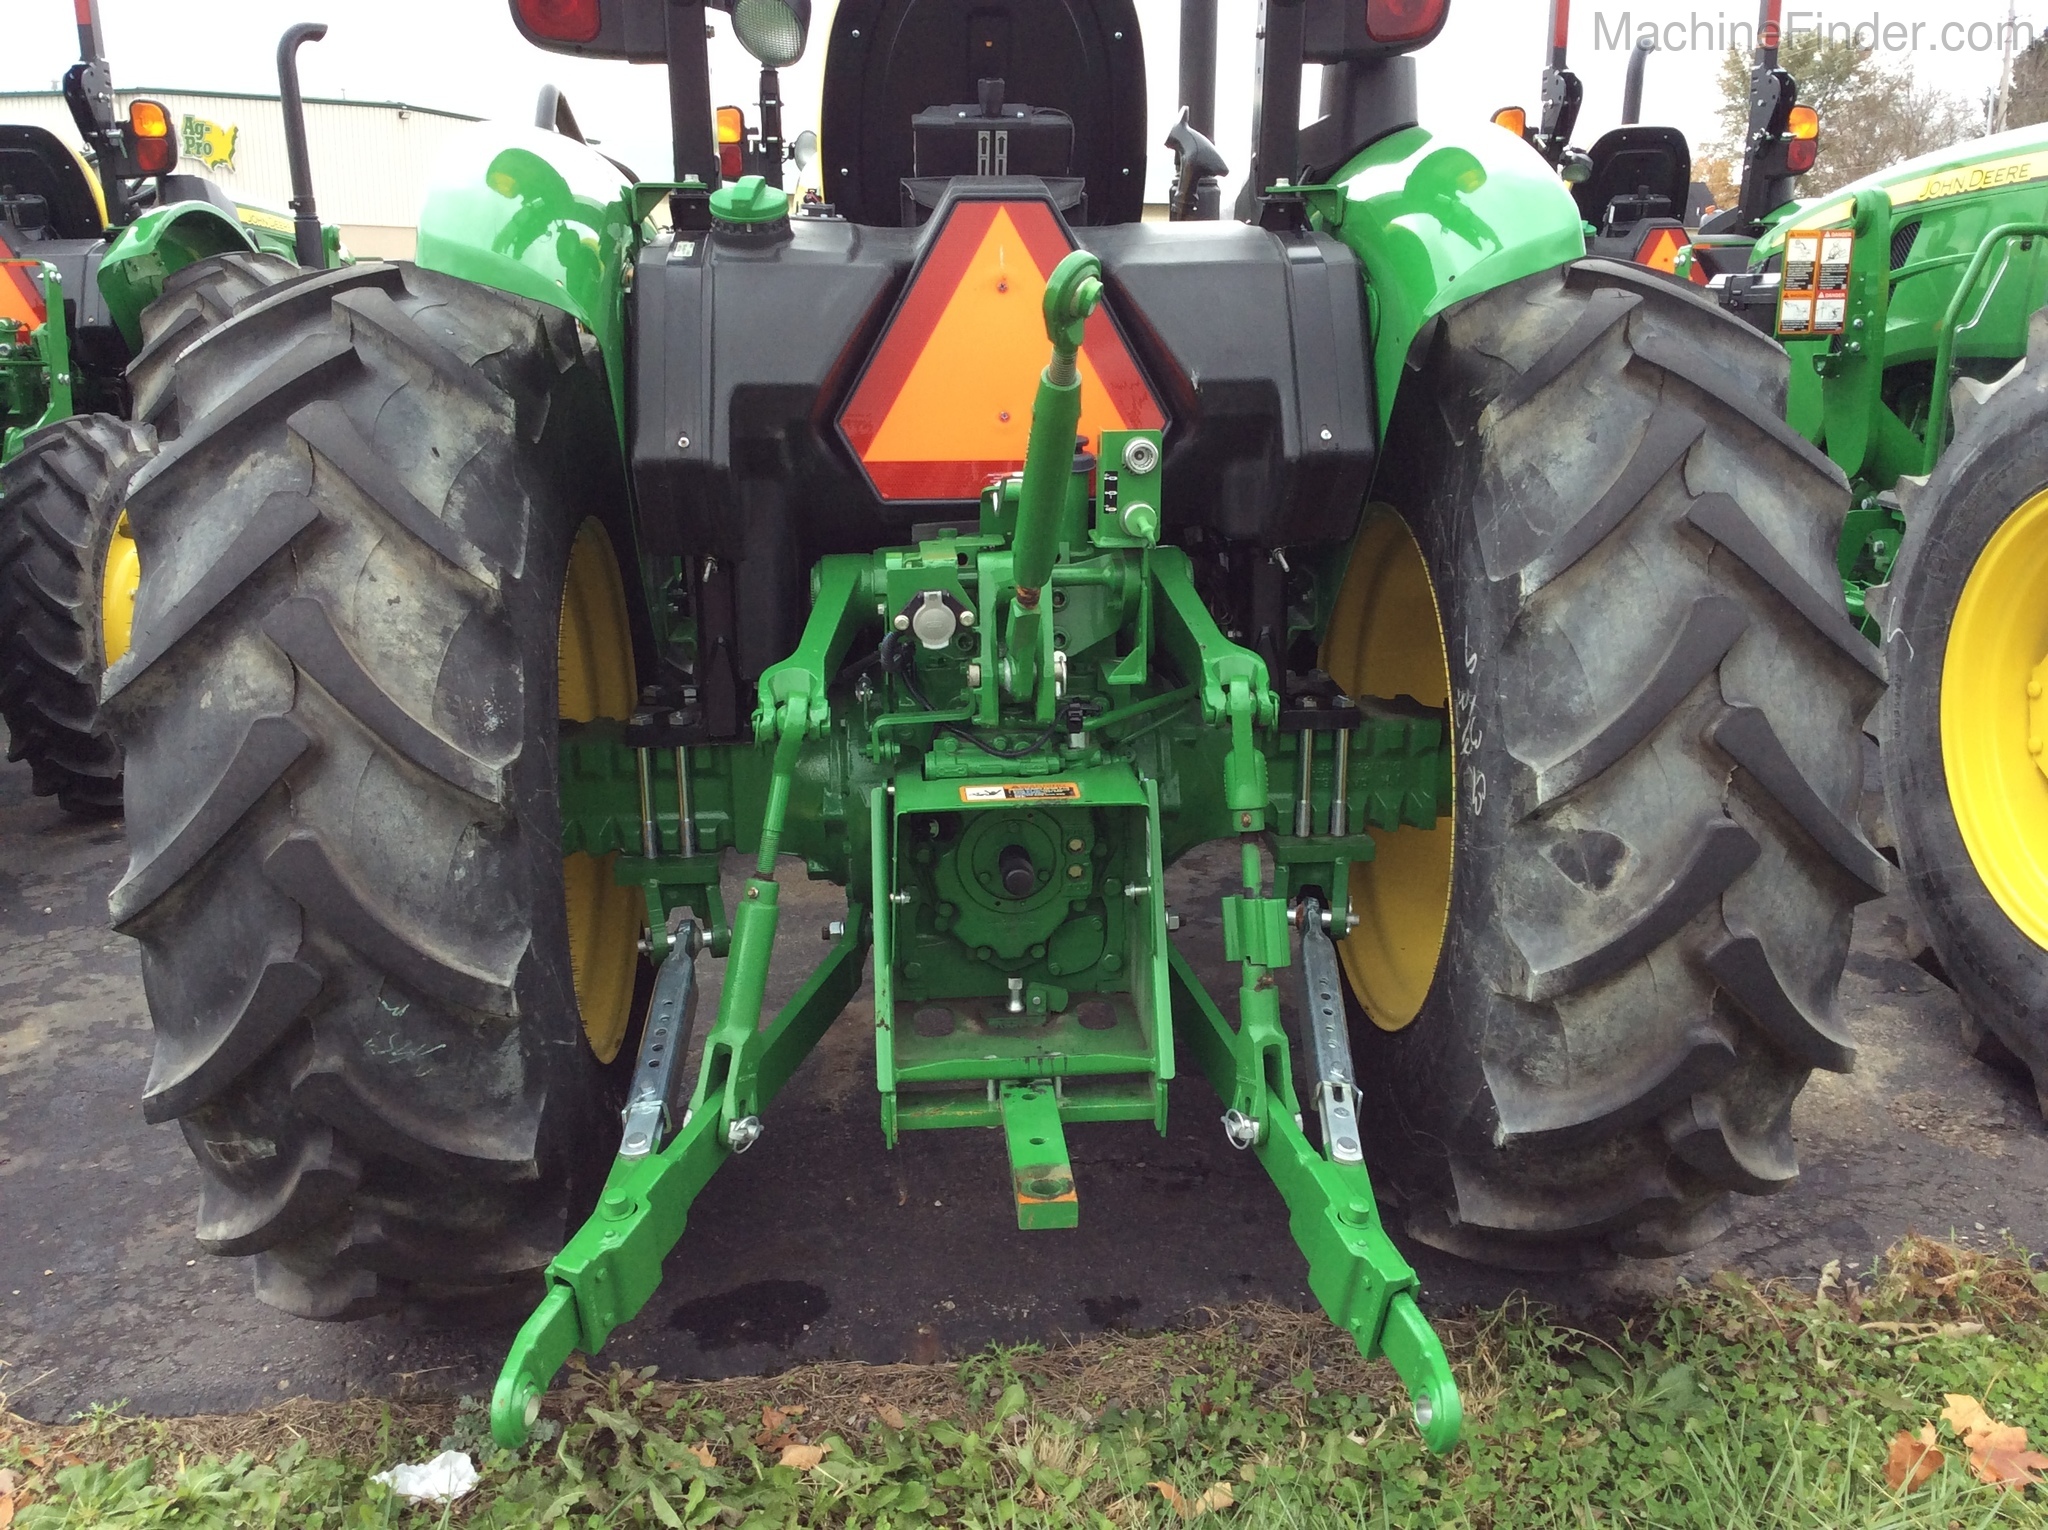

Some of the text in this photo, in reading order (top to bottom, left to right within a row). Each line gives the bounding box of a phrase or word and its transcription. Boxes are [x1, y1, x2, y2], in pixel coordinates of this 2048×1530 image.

[183, 115, 211, 141] Ag-
[184, 136, 212, 156] Pro
[1919, 162, 2031, 199] JOHN DEERE
